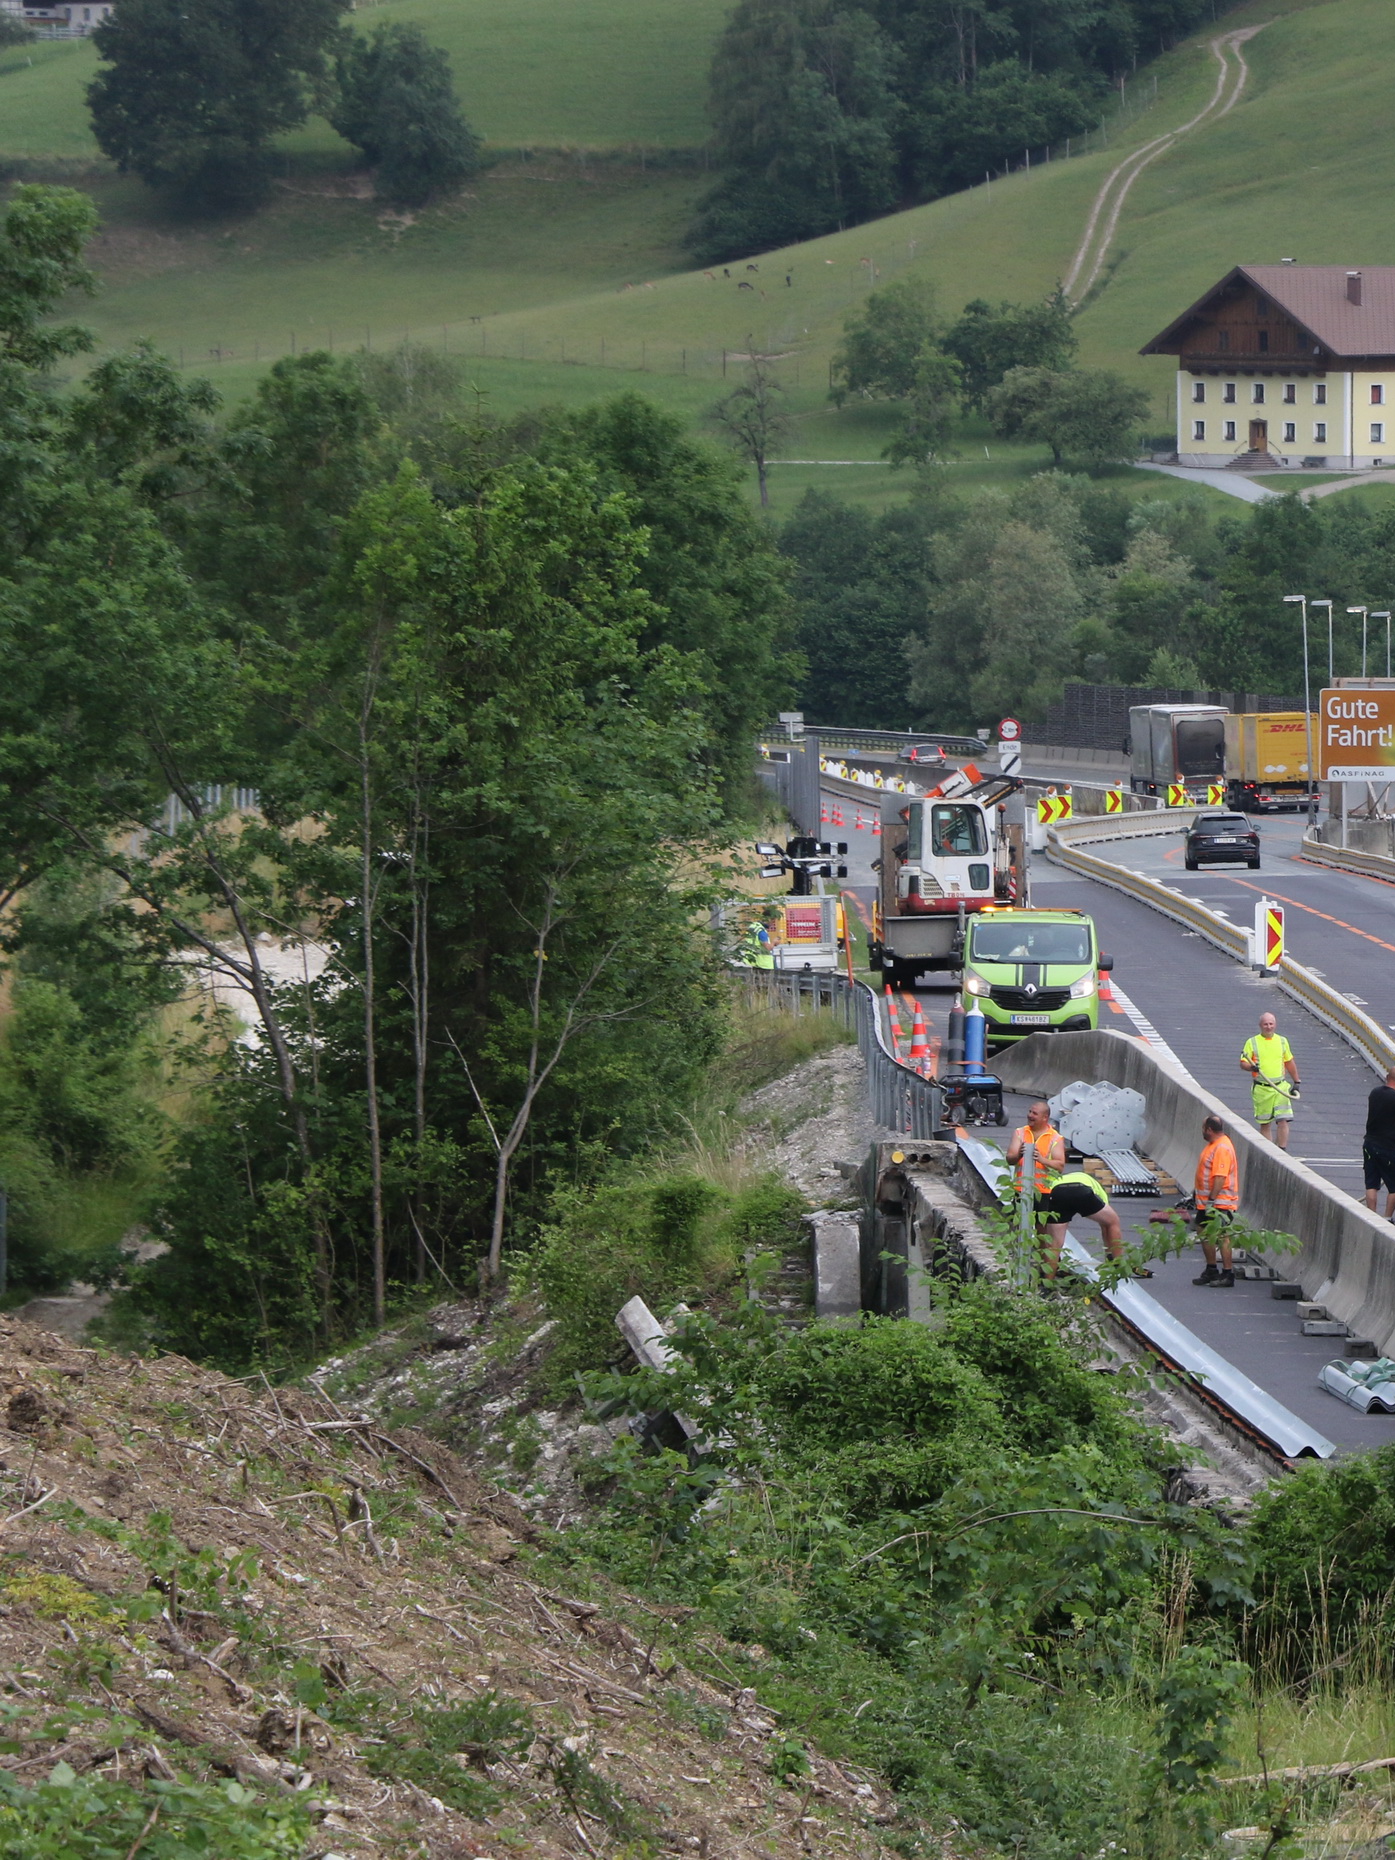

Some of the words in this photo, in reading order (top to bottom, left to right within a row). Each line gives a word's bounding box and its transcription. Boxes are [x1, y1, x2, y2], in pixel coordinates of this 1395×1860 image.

[1326, 696, 1379, 719] Gute
[1270, 724, 1307, 733] DHL
[1327, 724, 1393, 747] Fahrt!
